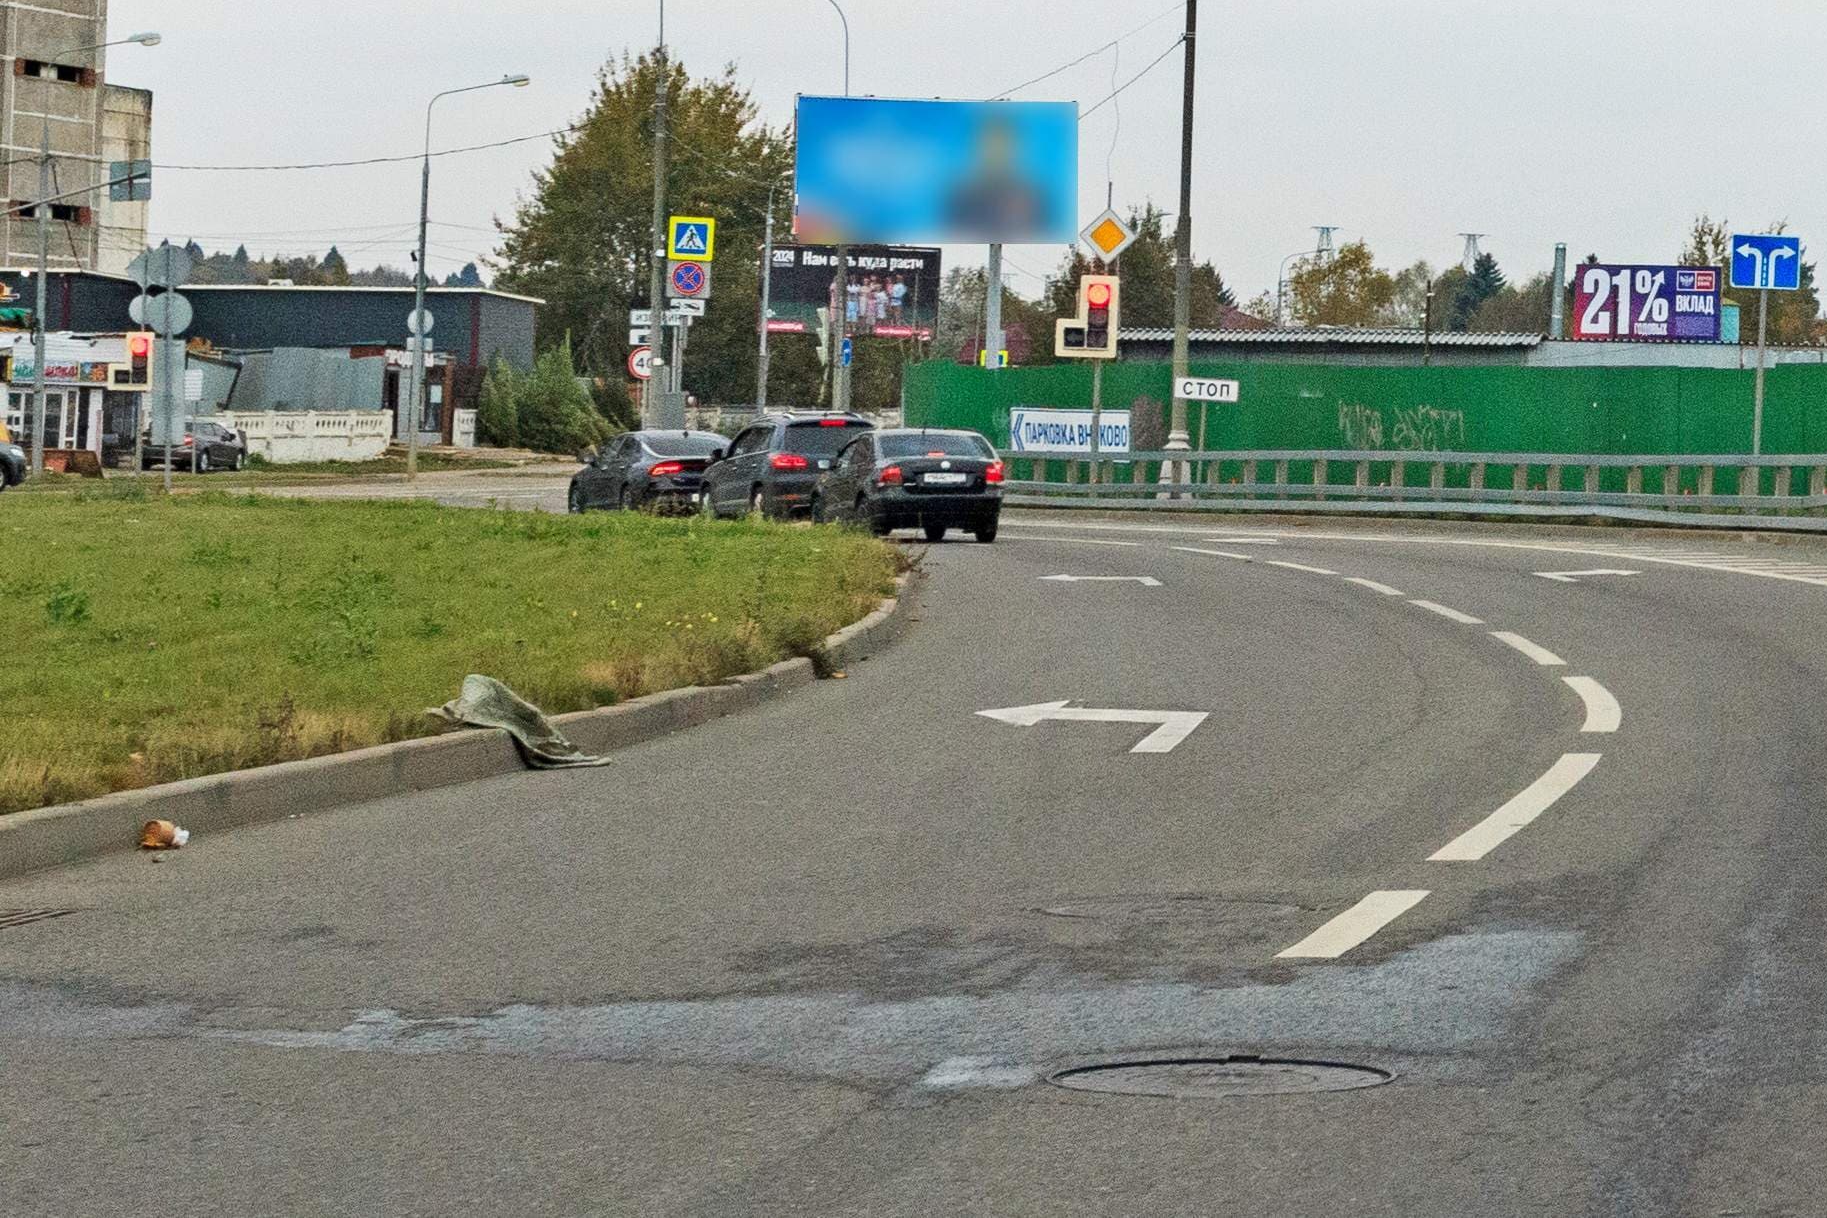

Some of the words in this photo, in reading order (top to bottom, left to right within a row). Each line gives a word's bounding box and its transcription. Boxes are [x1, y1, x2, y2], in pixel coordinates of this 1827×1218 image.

[772, 249, 795, 262] 2024
[802, 251, 828, 265] Нам
[829, 255, 857, 267] еь
[858, 256, 888, 270] куда
[889, 257, 924, 272] расти
[1580, 268, 1669, 335] 21%
[1675, 294, 1714, 315] ВКЛАД
[1183, 381, 1230, 397] СТОП
[1025, 422, 1076, 446] ПАРКОВКА
[1078, 424, 1127, 447] ВНКОВО
